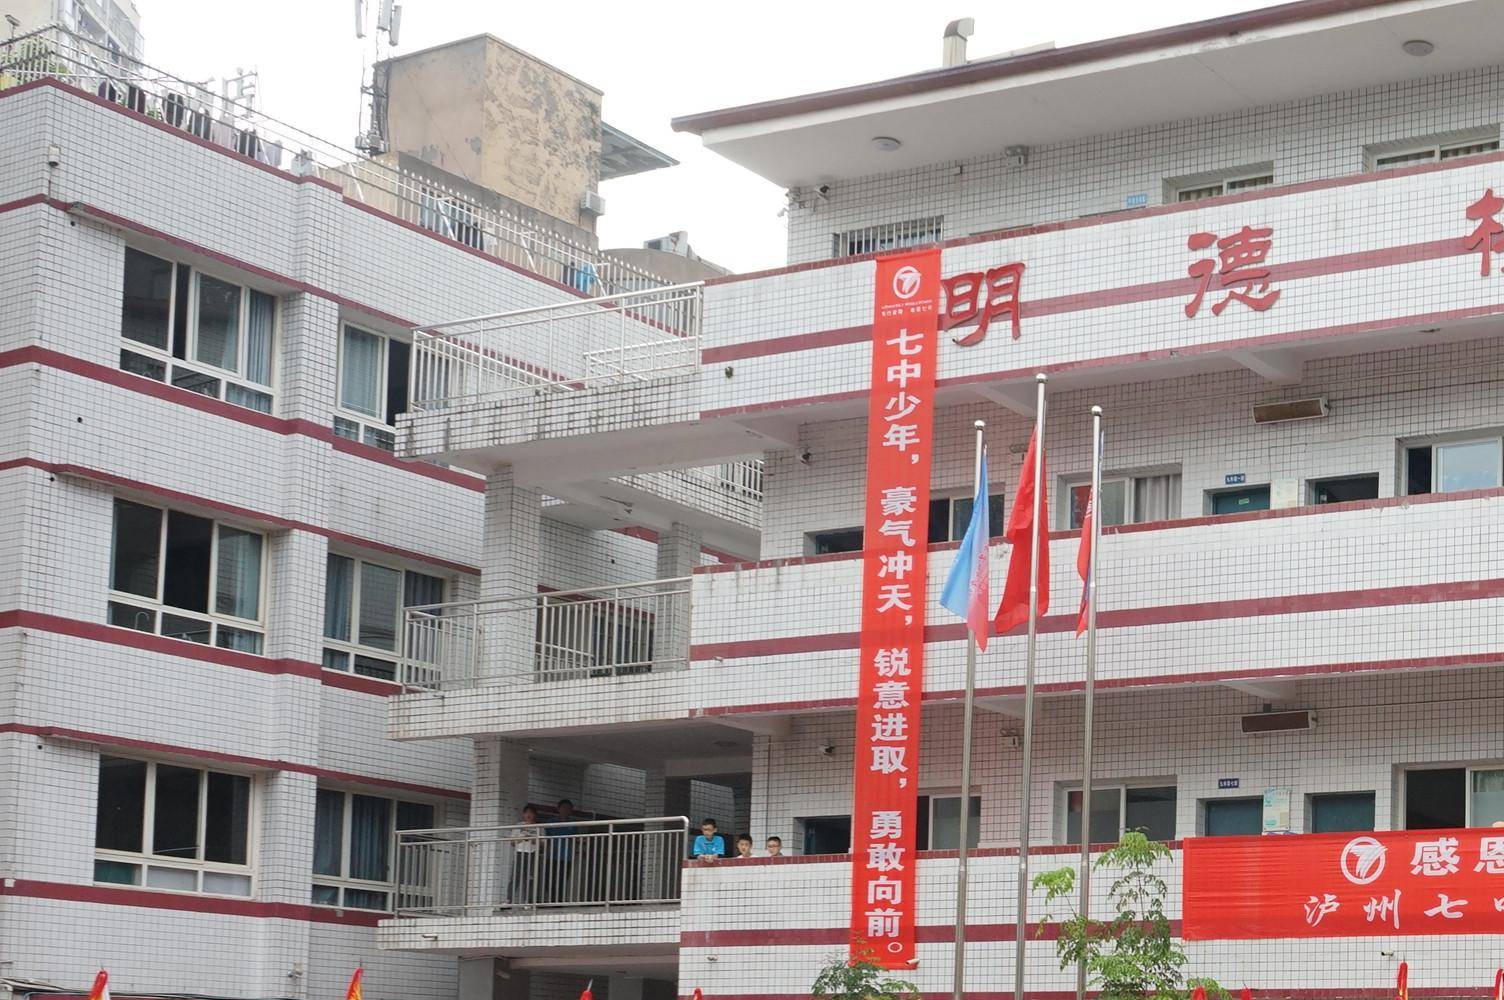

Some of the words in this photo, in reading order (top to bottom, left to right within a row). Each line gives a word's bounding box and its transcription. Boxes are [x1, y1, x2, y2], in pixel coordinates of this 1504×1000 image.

[882, 328, 924, 465] 七中少年，
[876, 486, 917, 626] 豪气冲天，
[870, 647, 912, 789] 锐意进取，
[864, 810, 906, 953] 勇敢向前。
